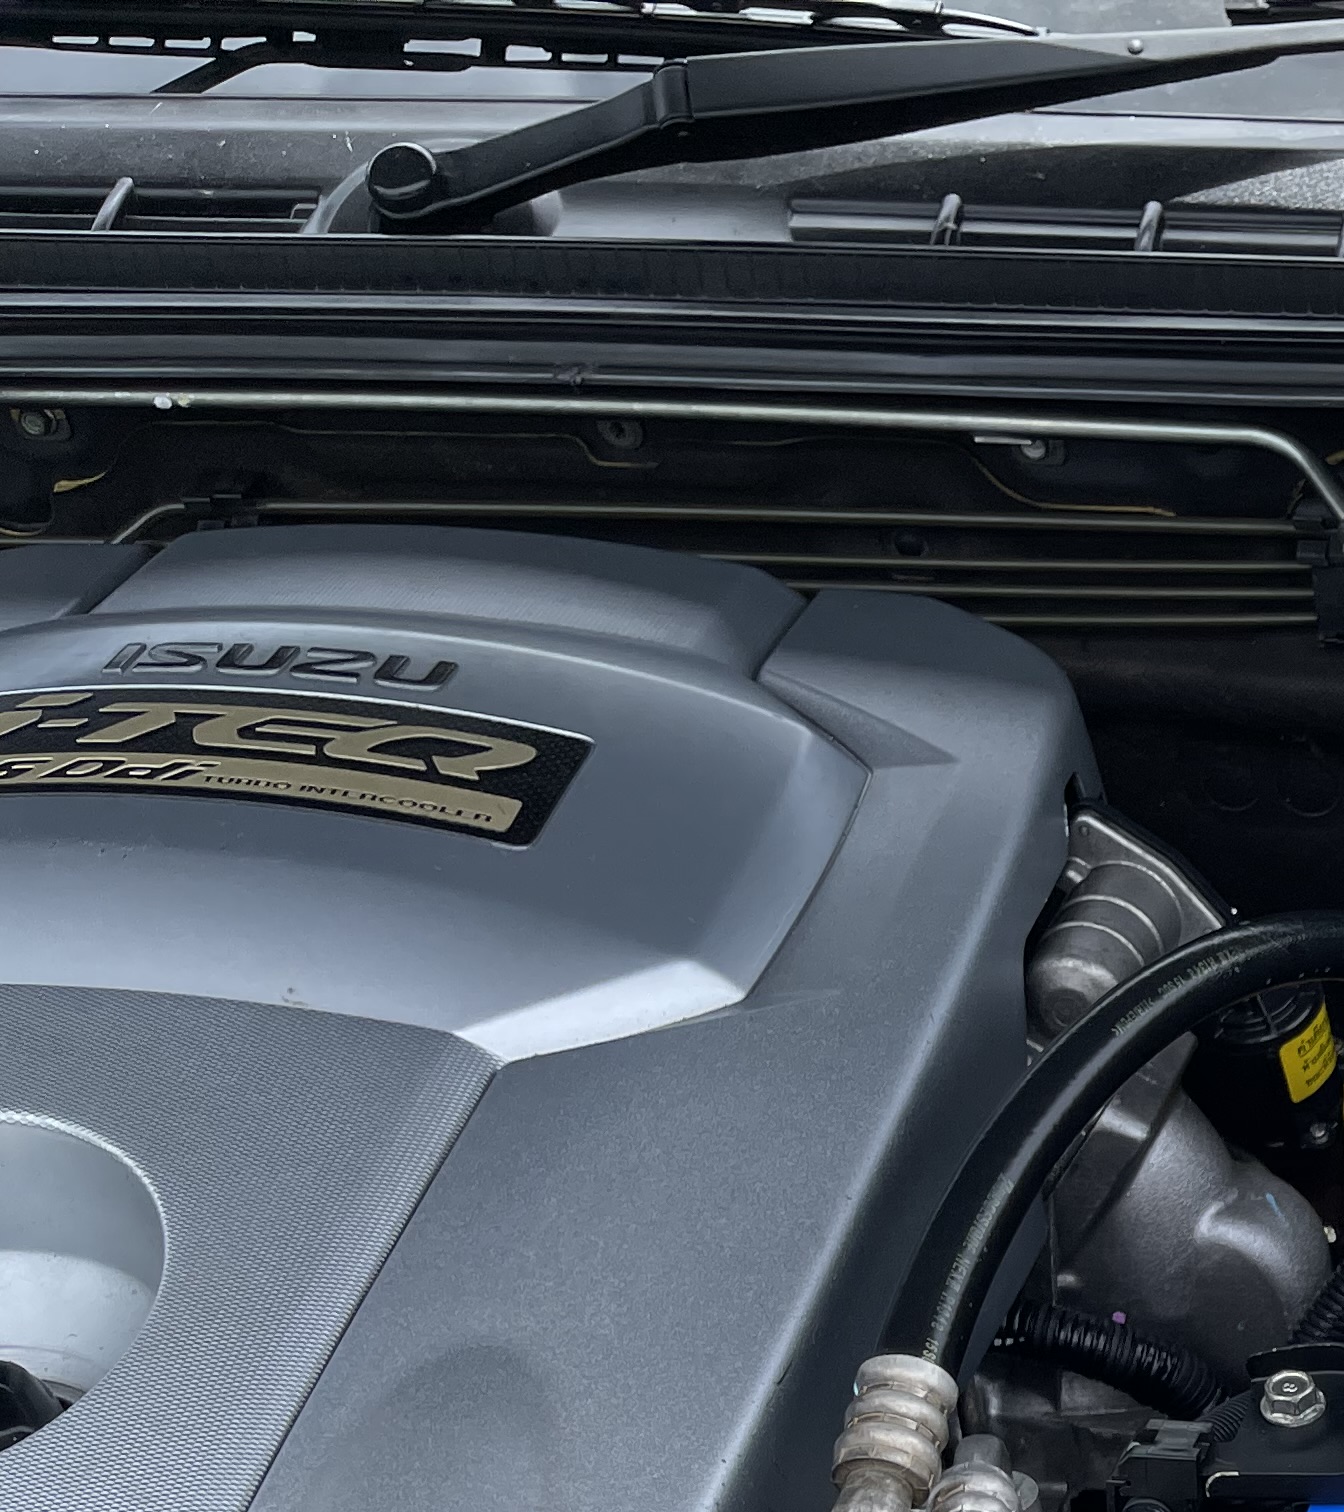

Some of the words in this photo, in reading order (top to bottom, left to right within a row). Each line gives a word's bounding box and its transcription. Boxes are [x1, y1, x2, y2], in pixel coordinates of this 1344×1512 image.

[101, 641, 459, 692] ISUZU
[204, 774, 292, 791] TURBO
[299, 784, 493, 823] INTERCOOLER
